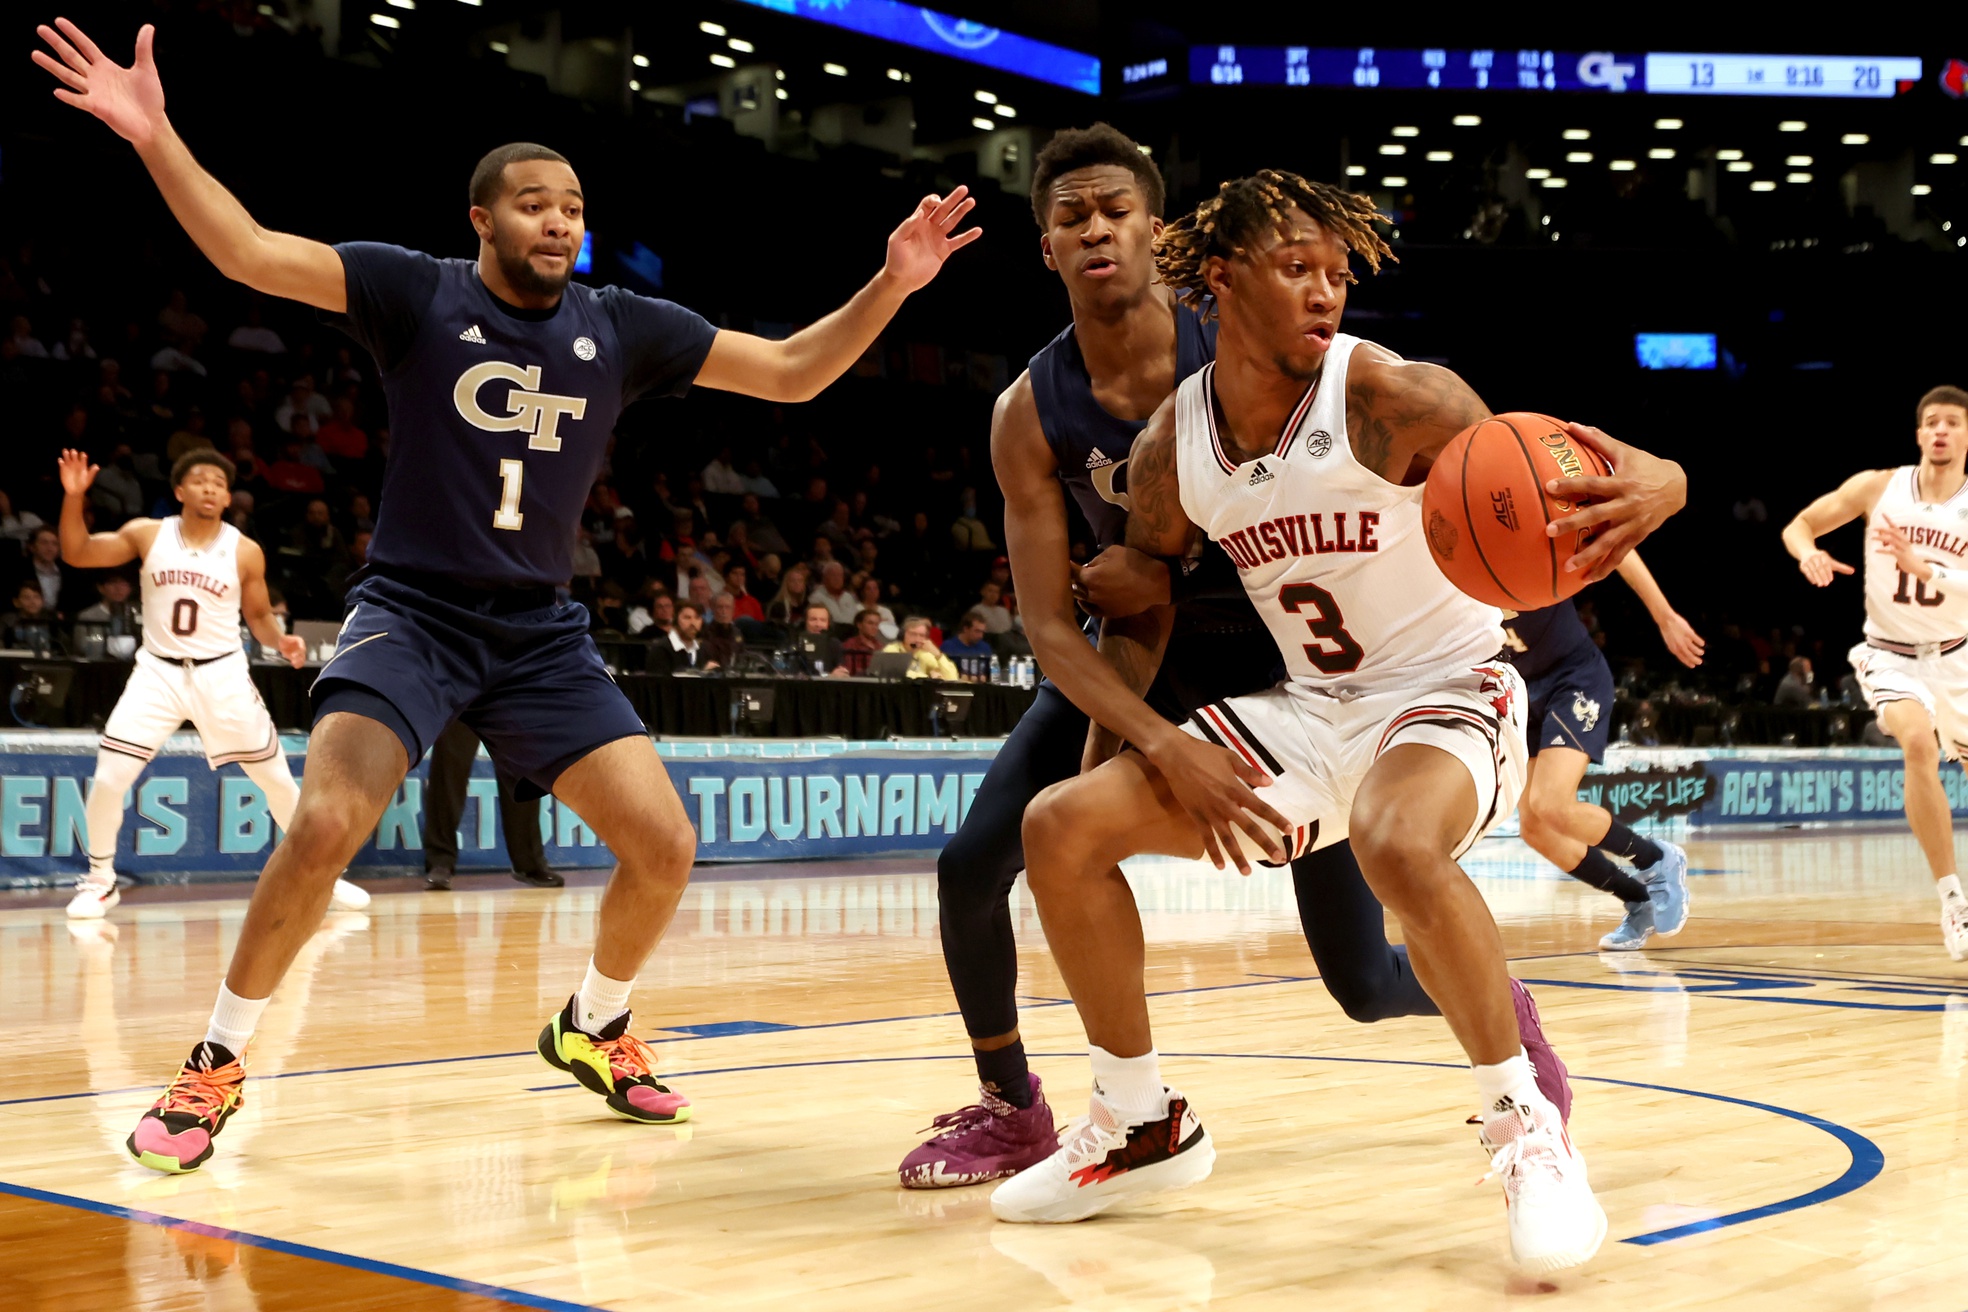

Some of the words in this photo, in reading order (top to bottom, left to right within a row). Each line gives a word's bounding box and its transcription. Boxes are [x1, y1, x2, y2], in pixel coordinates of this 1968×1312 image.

[1690, 63, 1714, 86] 13
[1854, 66, 1880, 89] 20
[459, 333, 487, 345] adidas
[453, 361, 587, 452] GT
[1310, 437, 1330, 447] ACC
[1085, 457, 1113, 469] adidas
[1249, 472, 1275, 487] adidas
[493, 458, 523, 531] 1
[1490, 491, 1511, 530] ACC
[151, 568, 229, 598] LOUISVILLE
[172, 598, 198, 636] 0
[1278, 582, 1364, 674] 3
[1608, 781, 1665, 815] YORK
[1667, 776, 1707, 806] LIFE
[1721, 772, 1773, 815] ACC
[1780, 770, 1853, 814] MEN'S
